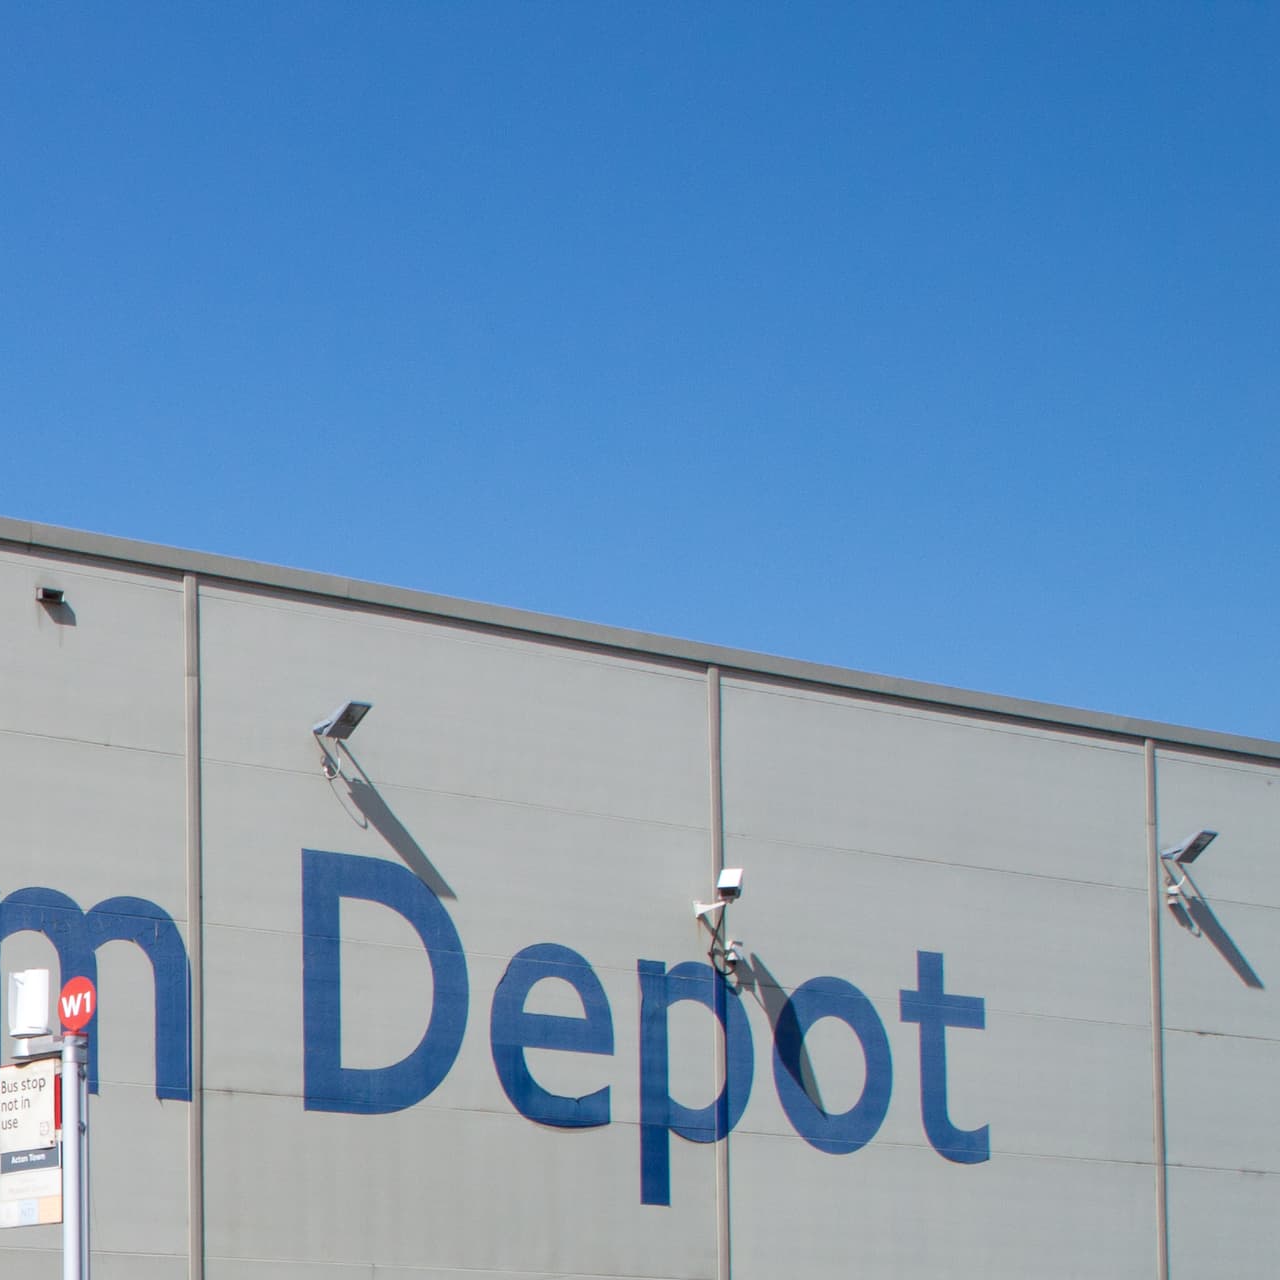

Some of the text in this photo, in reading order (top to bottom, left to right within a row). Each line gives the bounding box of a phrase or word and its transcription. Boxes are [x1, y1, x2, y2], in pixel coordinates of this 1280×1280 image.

[61, 990, 91, 1018] W1
[301, 848, 990, 1206] Depot
[1, 1077, 46, 1094] Bus stop
[1, 1096, 30, 1112] not in
[1, 1118, 18, 1130] use
